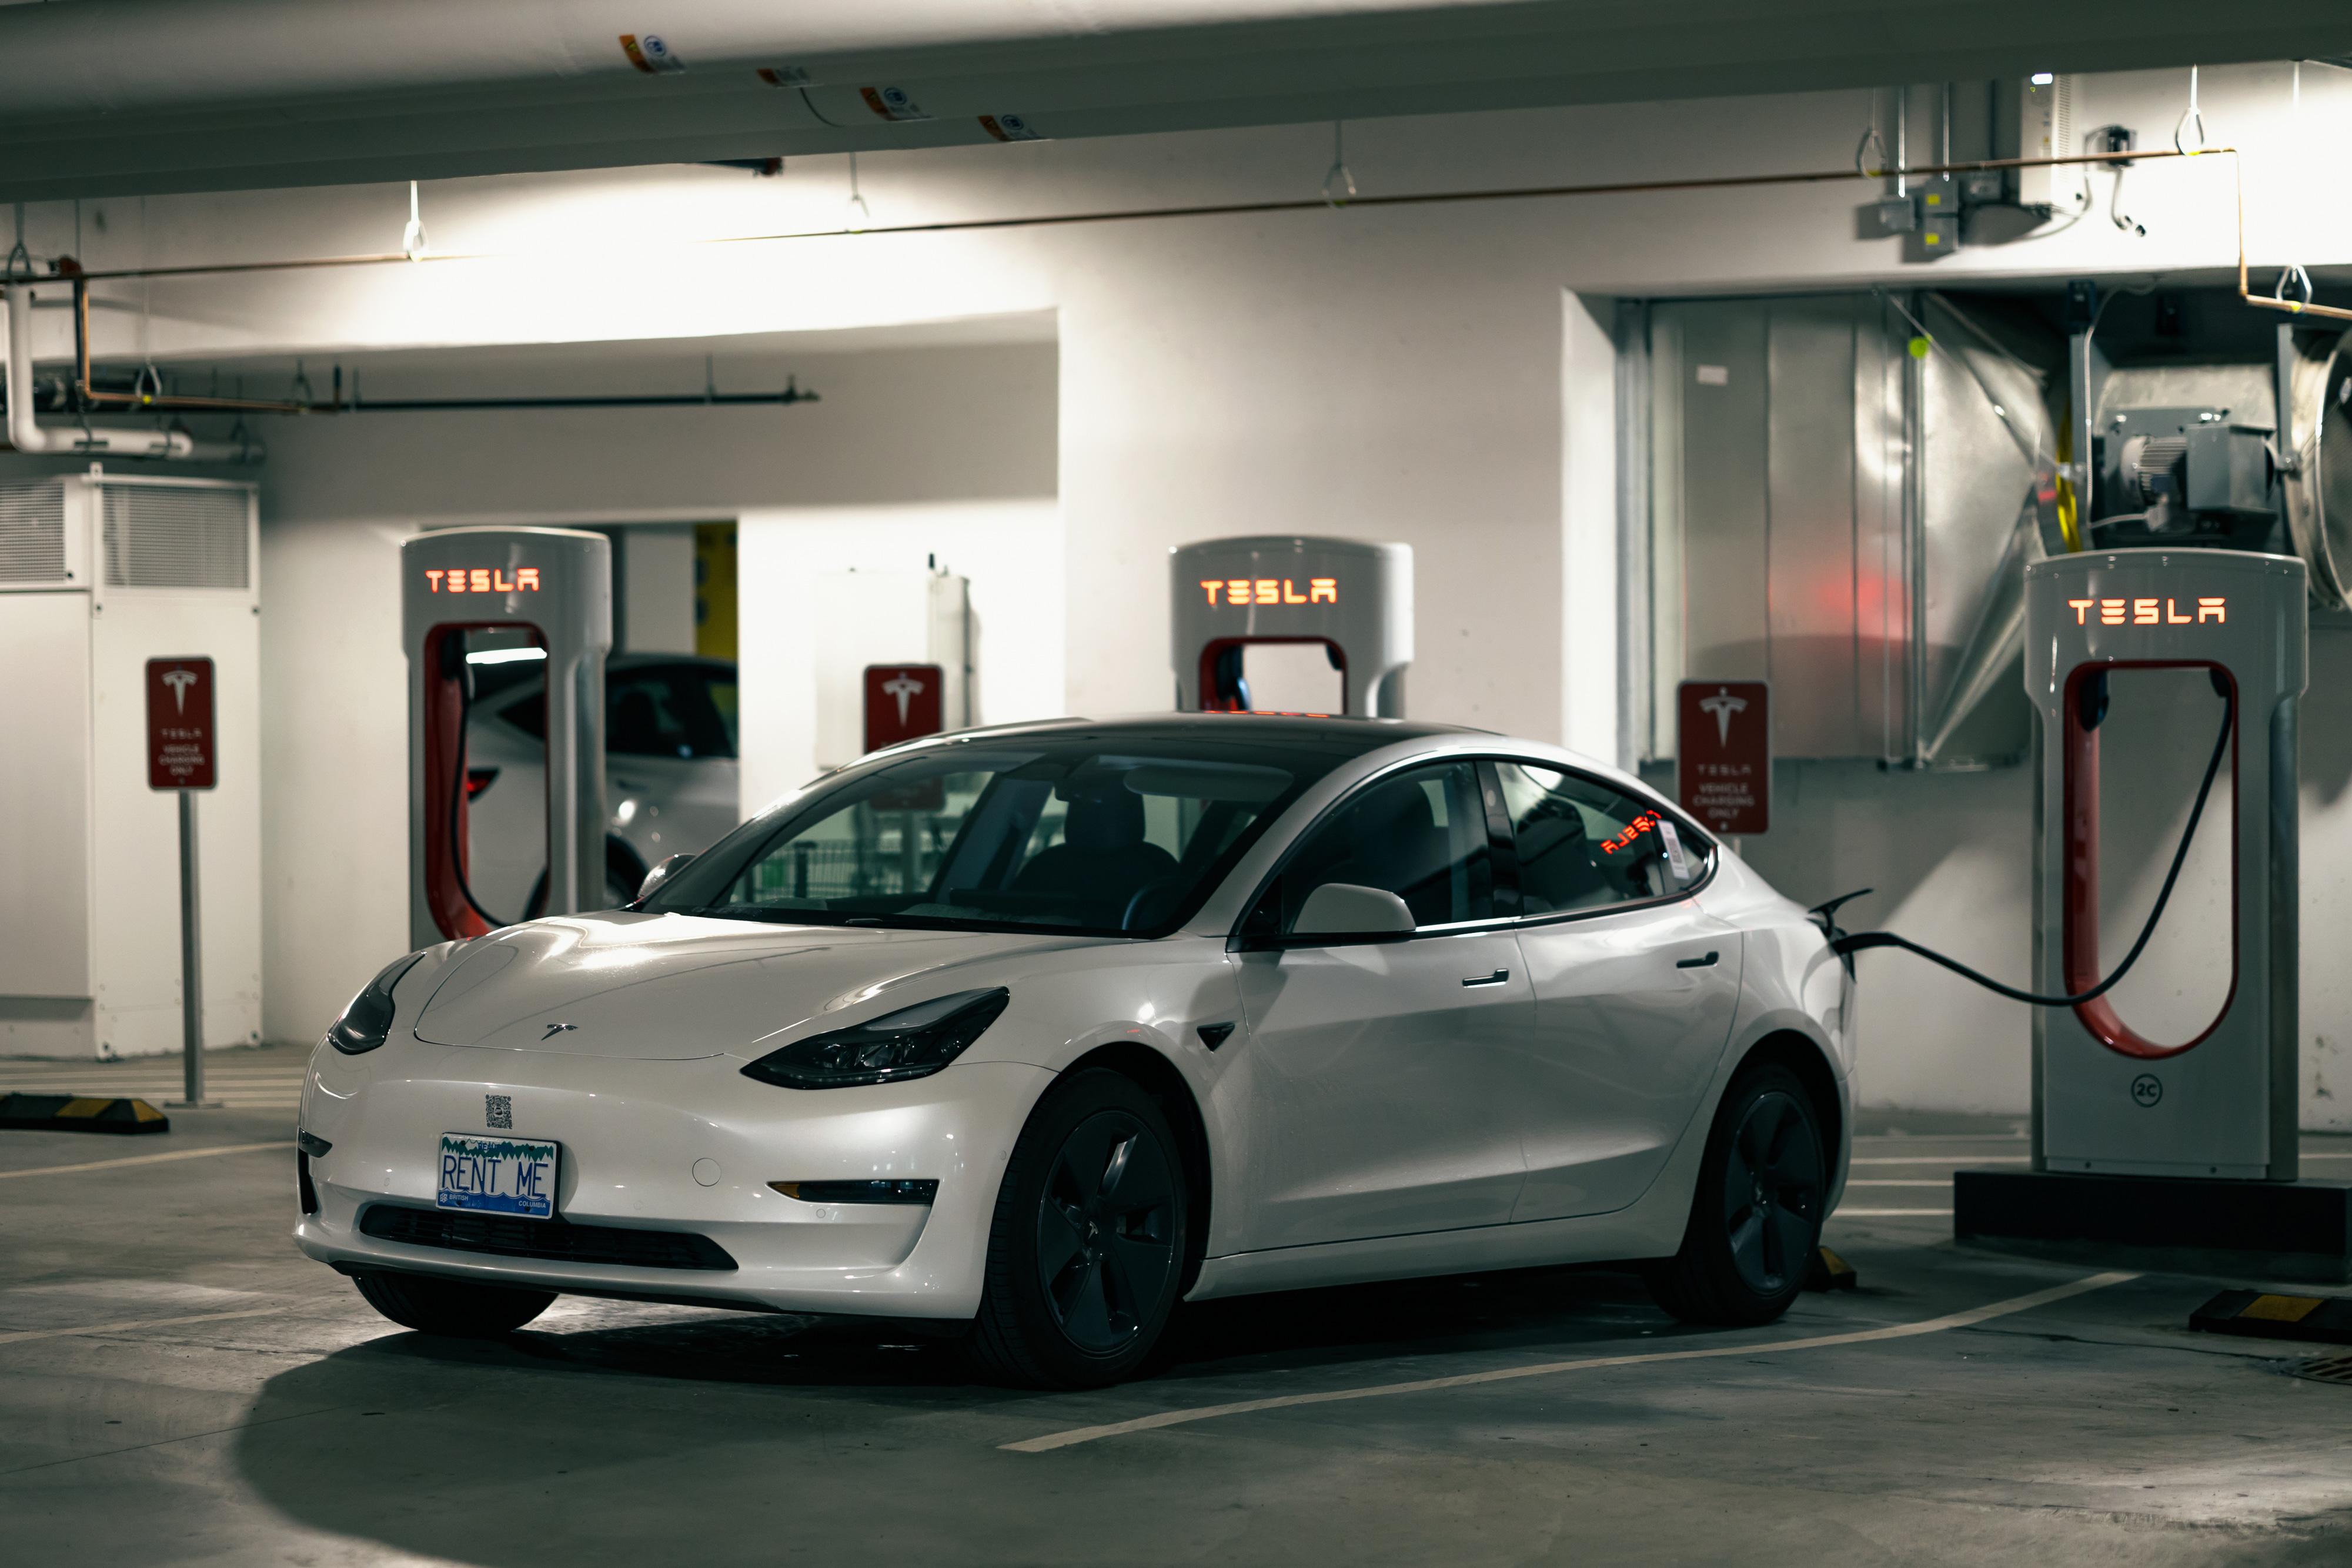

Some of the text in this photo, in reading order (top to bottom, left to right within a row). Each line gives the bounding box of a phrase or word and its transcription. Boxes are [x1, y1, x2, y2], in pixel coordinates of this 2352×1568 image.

[425, 568, 539, 593] TESLA
[1200, 579, 1337, 605] TESLA
[2067, 597, 2226, 625] TESLA
[1698, 764, 1751, 776] TESLA
[1699, 783, 1748, 794] VEHICLE
[1692, 795, 1755, 807] CHARGING
[1707, 807, 1739, 819] ONLY
[2136, 1082, 2157, 1098] 2C
[442, 1154, 549, 1198] RENT ME
